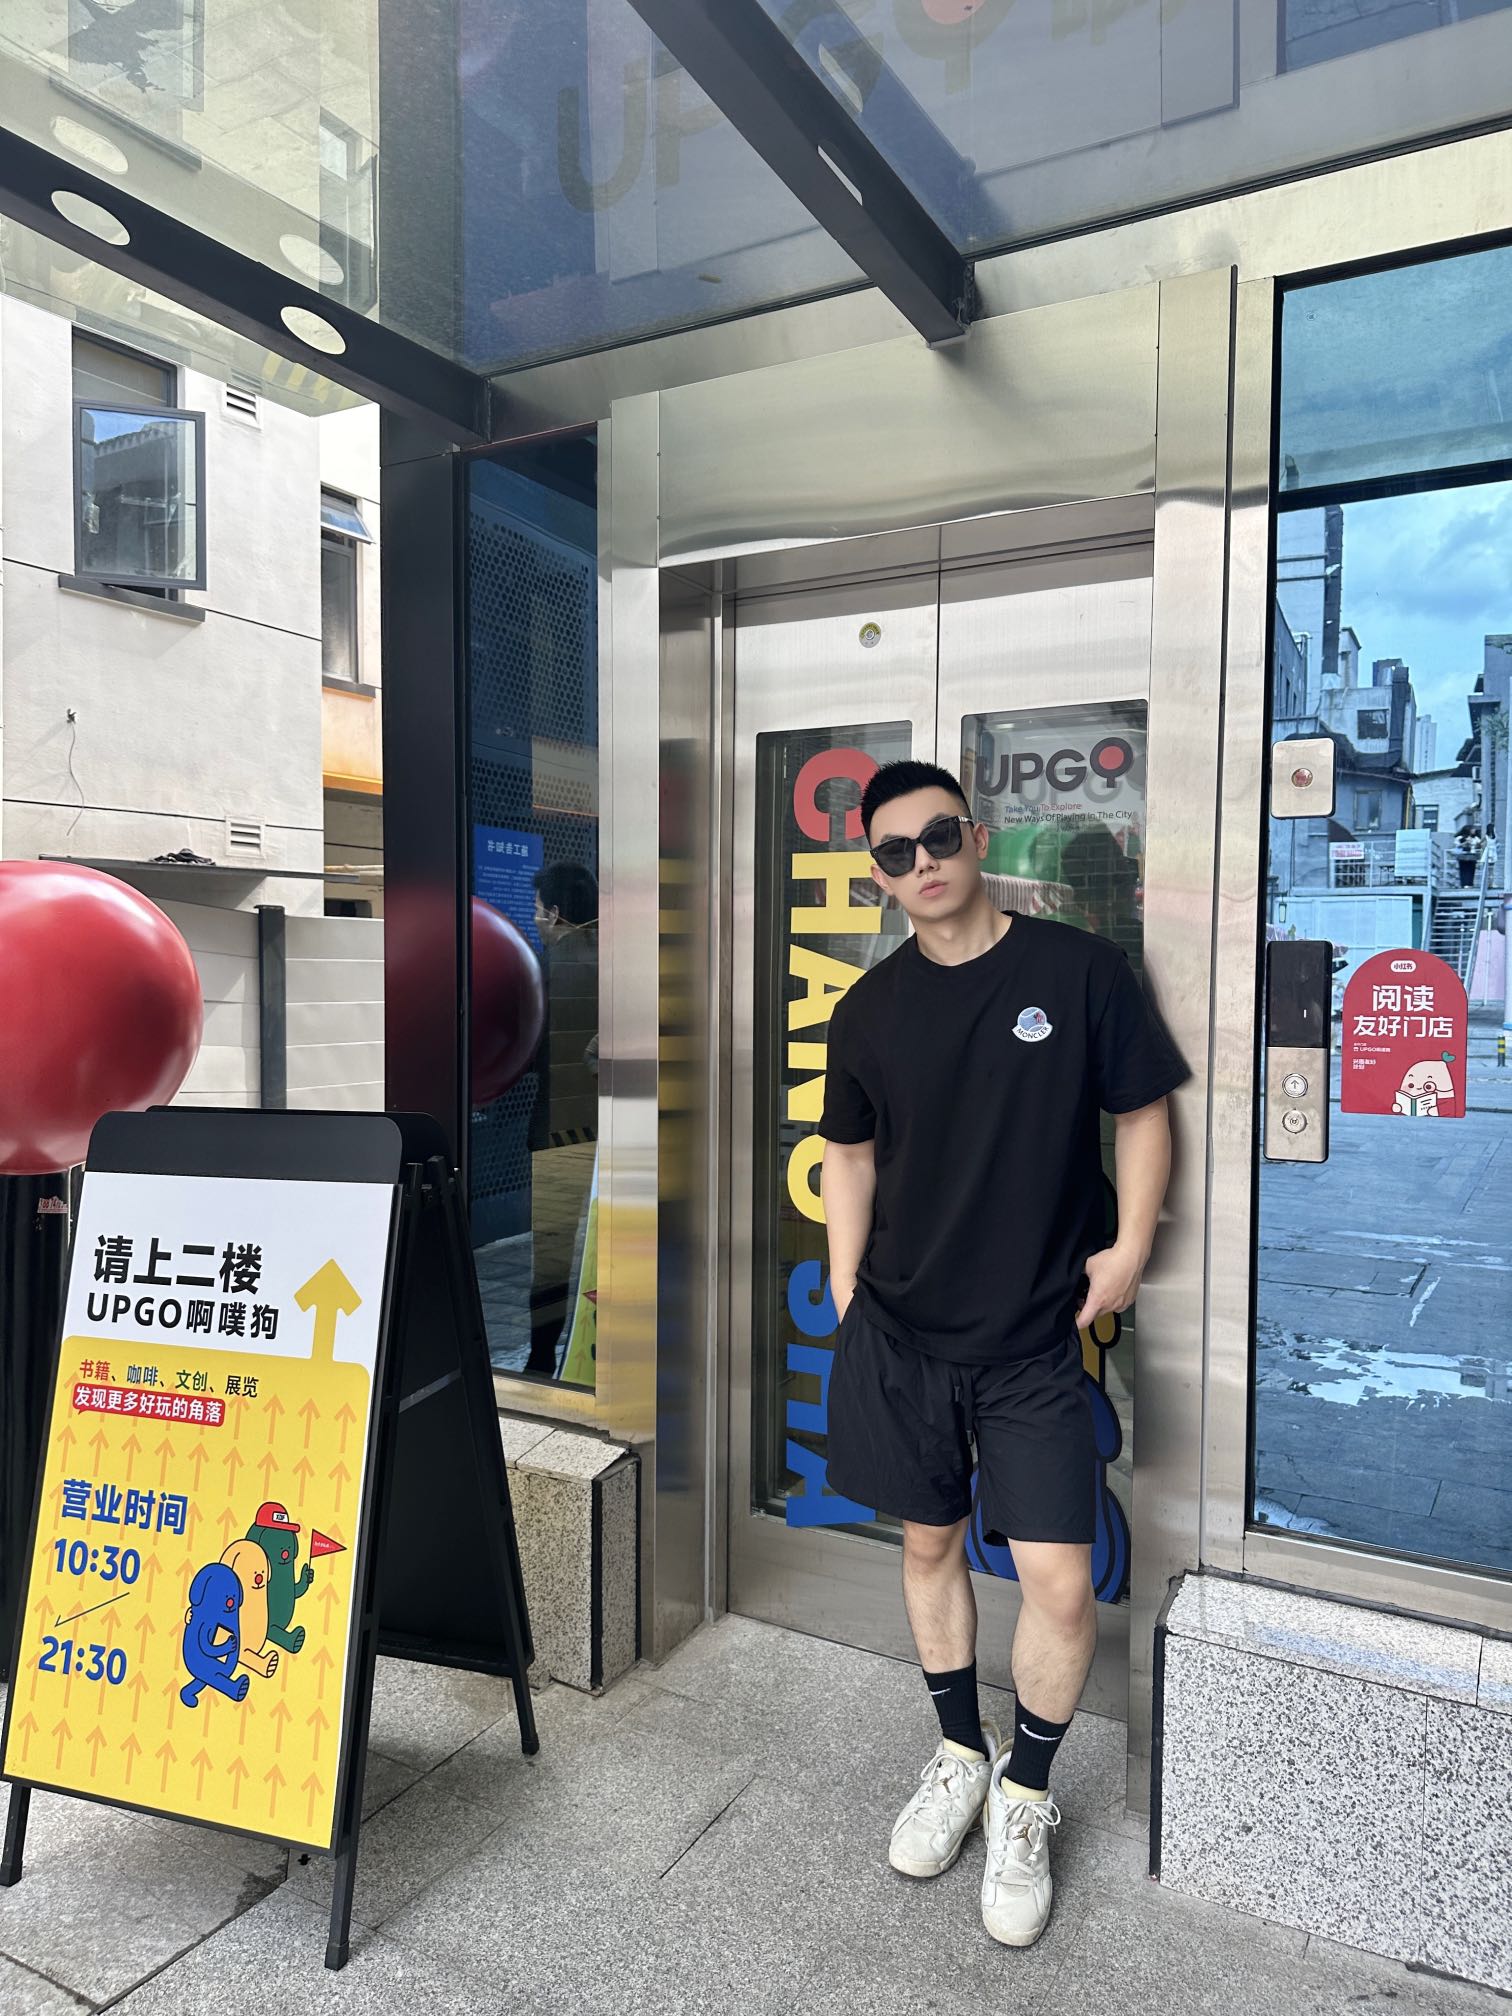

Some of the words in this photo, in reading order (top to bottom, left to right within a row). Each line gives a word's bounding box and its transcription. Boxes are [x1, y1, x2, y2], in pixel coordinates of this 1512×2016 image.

[975, 737, 1133, 796] UPGO
[1004, 816, 1023, 824] New
[1024, 814, 1044, 825] Ways
[1045, 813, 1056, 822] Of
[1056, 812, 1086, 824] Playing
[1097, 810, 1114, 819] The
[1115, 809, 1132, 820] City
[1005, 805, 1024, 814] Take
[1040, 803, 1051, 812] To
[1051, 802, 1082, 812] Explore
[1393, 962, 1413, 970] 小红书
[1372, 984, 1434, 1012] 阅读
[1016, 1025, 1050, 1039] MONCLER
[1353, 1015, 1453, 1038] 友好门店
[93, 1234, 263, 1295] 请上二楼
[79, 1358, 259, 1398] 书籍、咖啡、文创、展览
[74, 1386, 223, 1424] 发现更多好玩的角落
[61, 1478, 189, 1536] 营业时间
[54, 1537, 141, 1585] 10:30
[38, 1635, 127, 1685] 21:30
